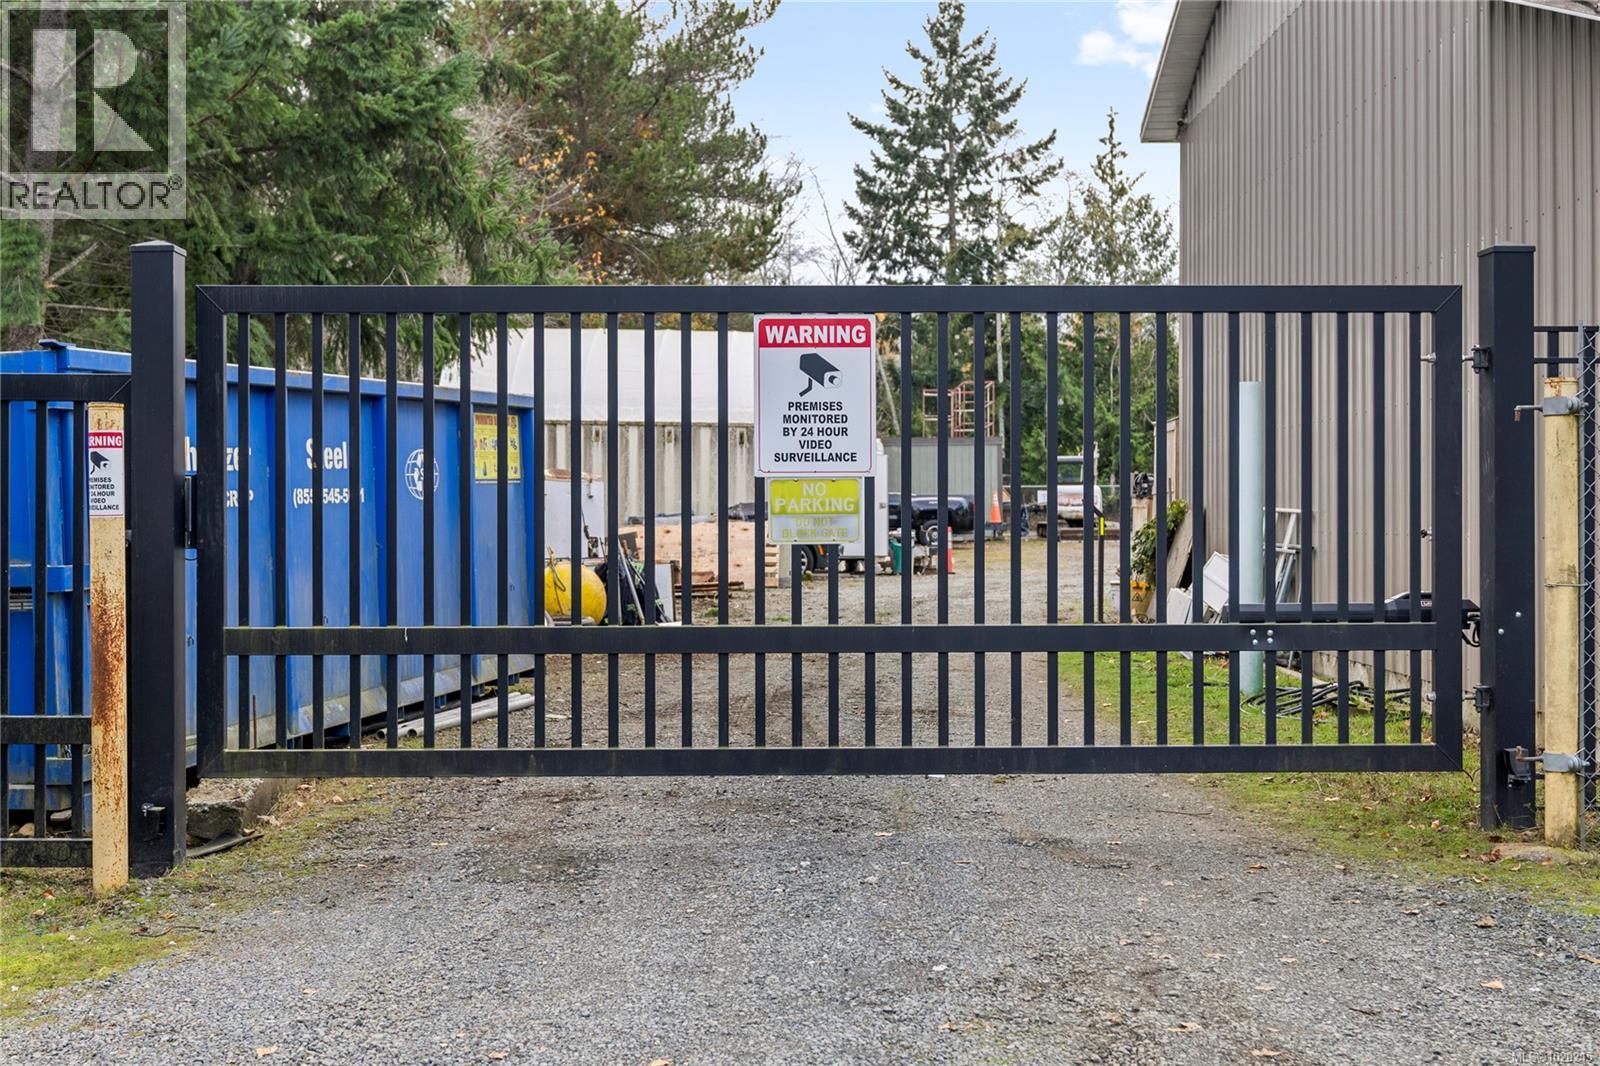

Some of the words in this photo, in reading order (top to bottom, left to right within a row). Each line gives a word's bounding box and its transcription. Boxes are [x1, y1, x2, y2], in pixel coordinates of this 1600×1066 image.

[764, 324, 867, 344] WARNING
[787, 401, 843, 411] PREMISES
[782, 414, 848, 424] MONITORED
[782, 427, 797, 437] BY
[801, 427, 814, 437] 24
[817, 427, 848, 437] HOUR
[89, 435, 122, 446] RNING
[798, 440, 833, 450] VIDEO
[305, 437, 348, 470] Seel
[773, 452, 858, 463] SURVEILLANCE
[803, 482, 827, 496] NO
[774, 497, 855, 512] PARKING
[814, 517, 833, 527] NOT
